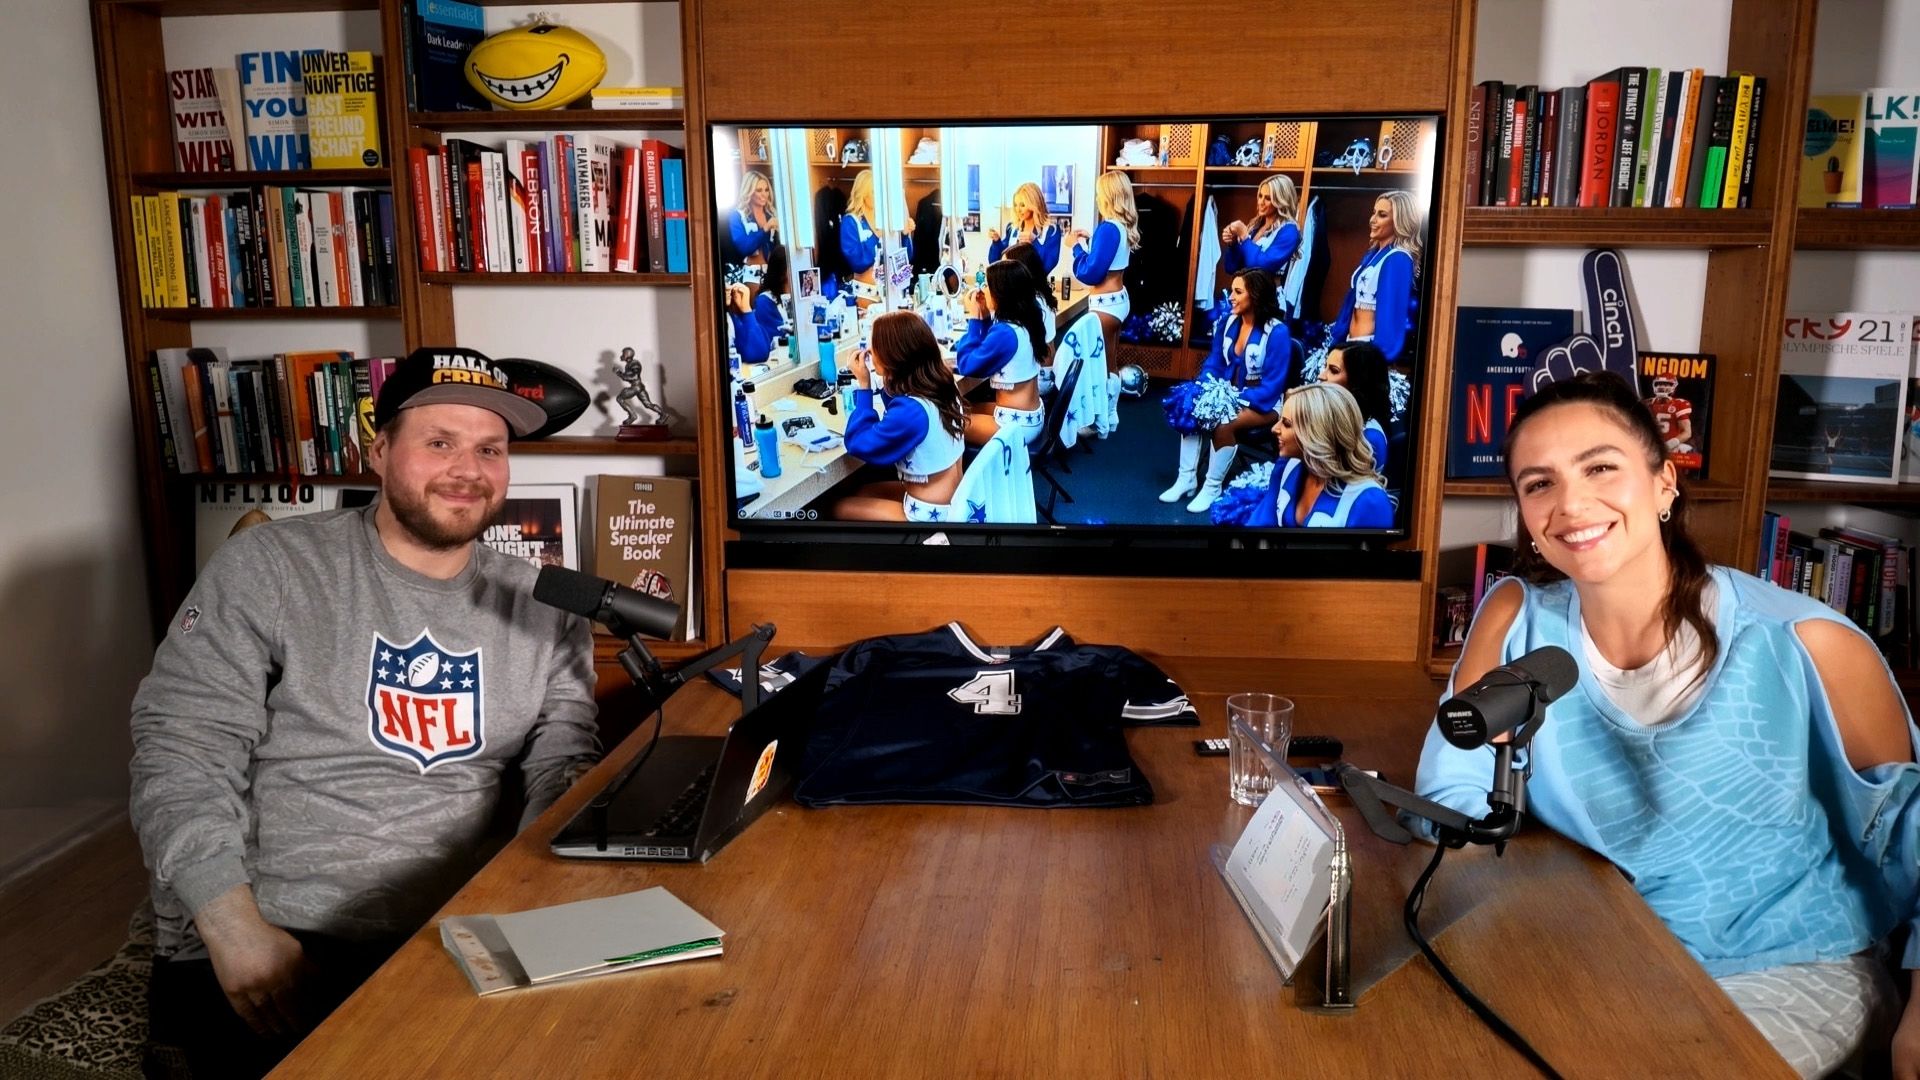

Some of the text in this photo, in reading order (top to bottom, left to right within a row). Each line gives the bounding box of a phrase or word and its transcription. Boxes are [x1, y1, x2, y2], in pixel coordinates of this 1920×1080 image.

[427, 33, 442, 47] Dark
[241, 50, 303, 86] FIN
[302, 51, 350, 75] UNVER
[304, 72, 377, 96] NÜNFTIGE
[307, 96, 344, 117] GAST
[308, 116, 366, 138] FREUND
[1468, 101, 1481, 143] OPEN
[1503, 98, 1516, 159] FOOTBALL LEAKS
[1617, 73, 1640, 190] THE DYNASTY JEFF BENEDICT
[1652, 112, 1663, 135] TEAM
[310, 135, 366, 158] SCHAFT
[1522, 116, 1534, 187] ROGER FEDERER
[1592, 108, 1610, 181] JORDAN
[576, 147, 591, 209] PLAYMAKERS
[525, 155, 543, 235] LEBRON
[163, 199, 177, 281] LANCE ARMSTRONG
[291, 251, 301, 280] DIGITAL
[1603, 288, 1625, 349] cinch
[1858, 319, 1895, 343] 21
[1782, 341, 1905, 357] LYMPISCHE SPIELE
[432, 354, 492, 376] HALL
[1486, 365, 1514, 374] AMERICAN
[628, 500, 656, 515] The
[483, 525, 522, 542] ONE
[609, 516, 675, 531] Ultimate
[610, 532, 673, 546] Sneaker
[1775, 527, 1787, 561] MESSI
[623, 546, 661, 561] Book
[947, 669, 1022, 715] 4
[379, 690, 472, 753] NFL
